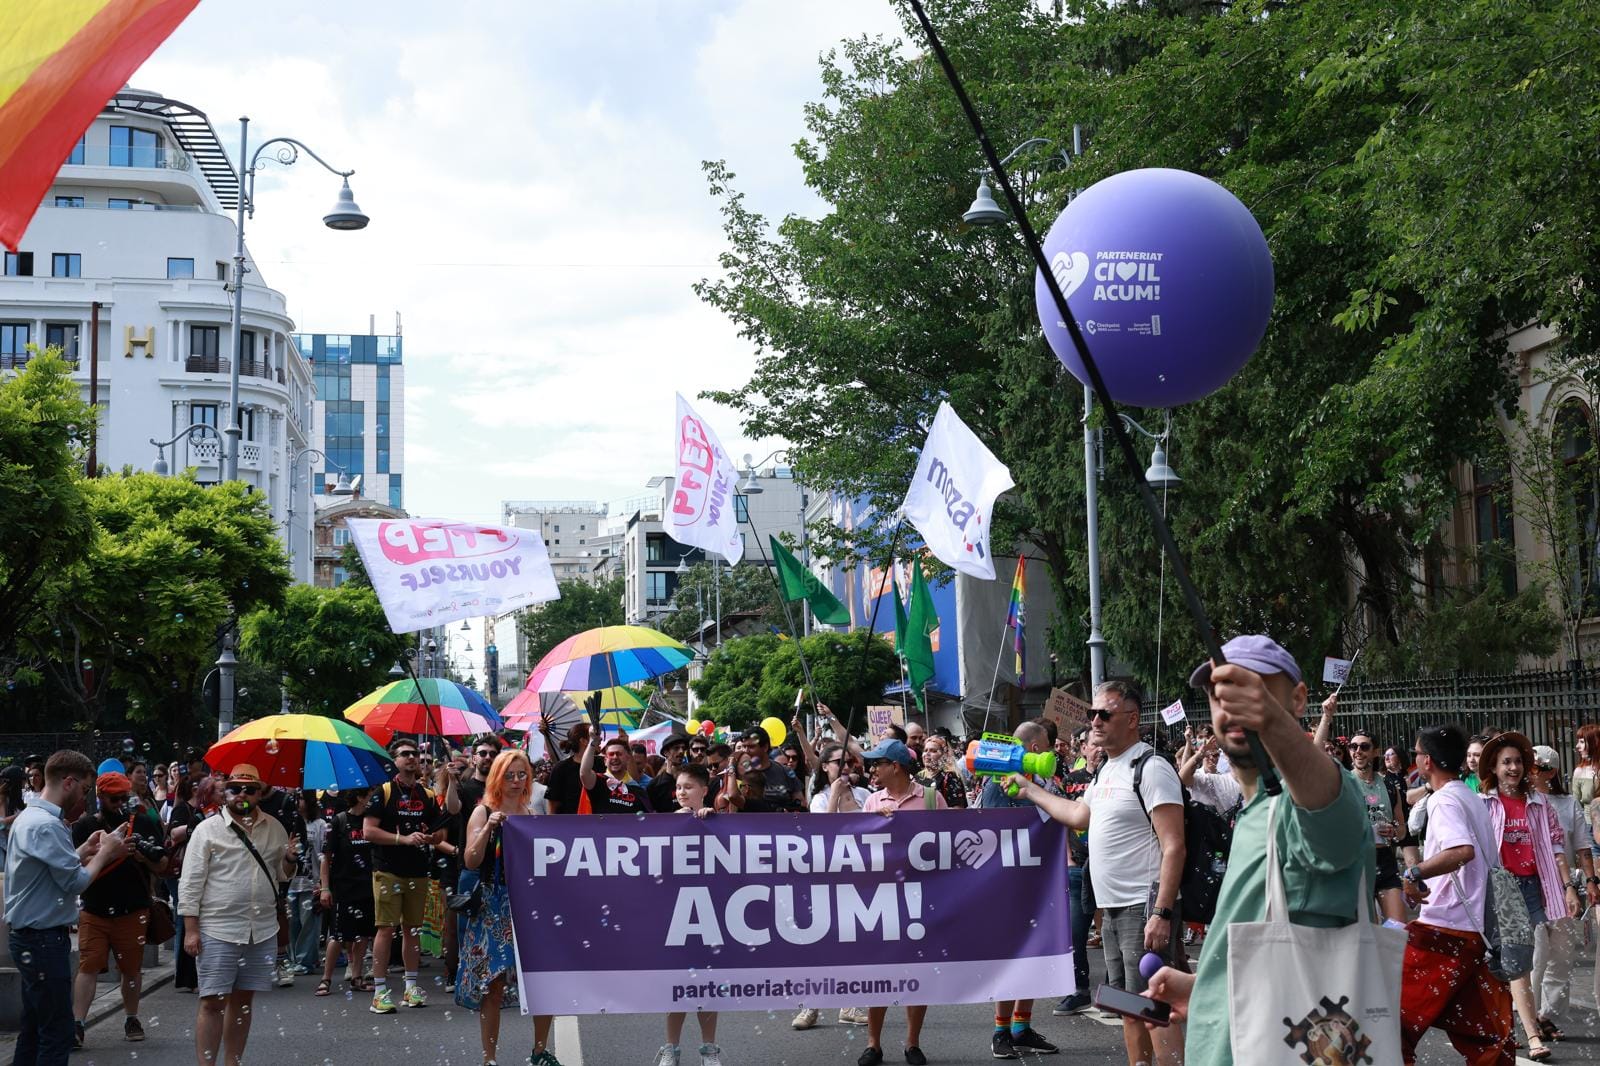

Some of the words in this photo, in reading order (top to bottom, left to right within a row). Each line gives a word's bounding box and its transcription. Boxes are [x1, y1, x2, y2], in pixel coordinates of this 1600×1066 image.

[1096, 251, 1163, 261] PARTENERIAT
[1093, 284, 1161, 301] ACUM!
[123, 324, 154, 359] H
[869, 710, 892, 724] QUEER
[533, 833, 892, 877] PARTENERIAT
[664, 881, 927, 947] ACUM!
[671, 976, 920, 1002] parteneriatcivilacum.ro
